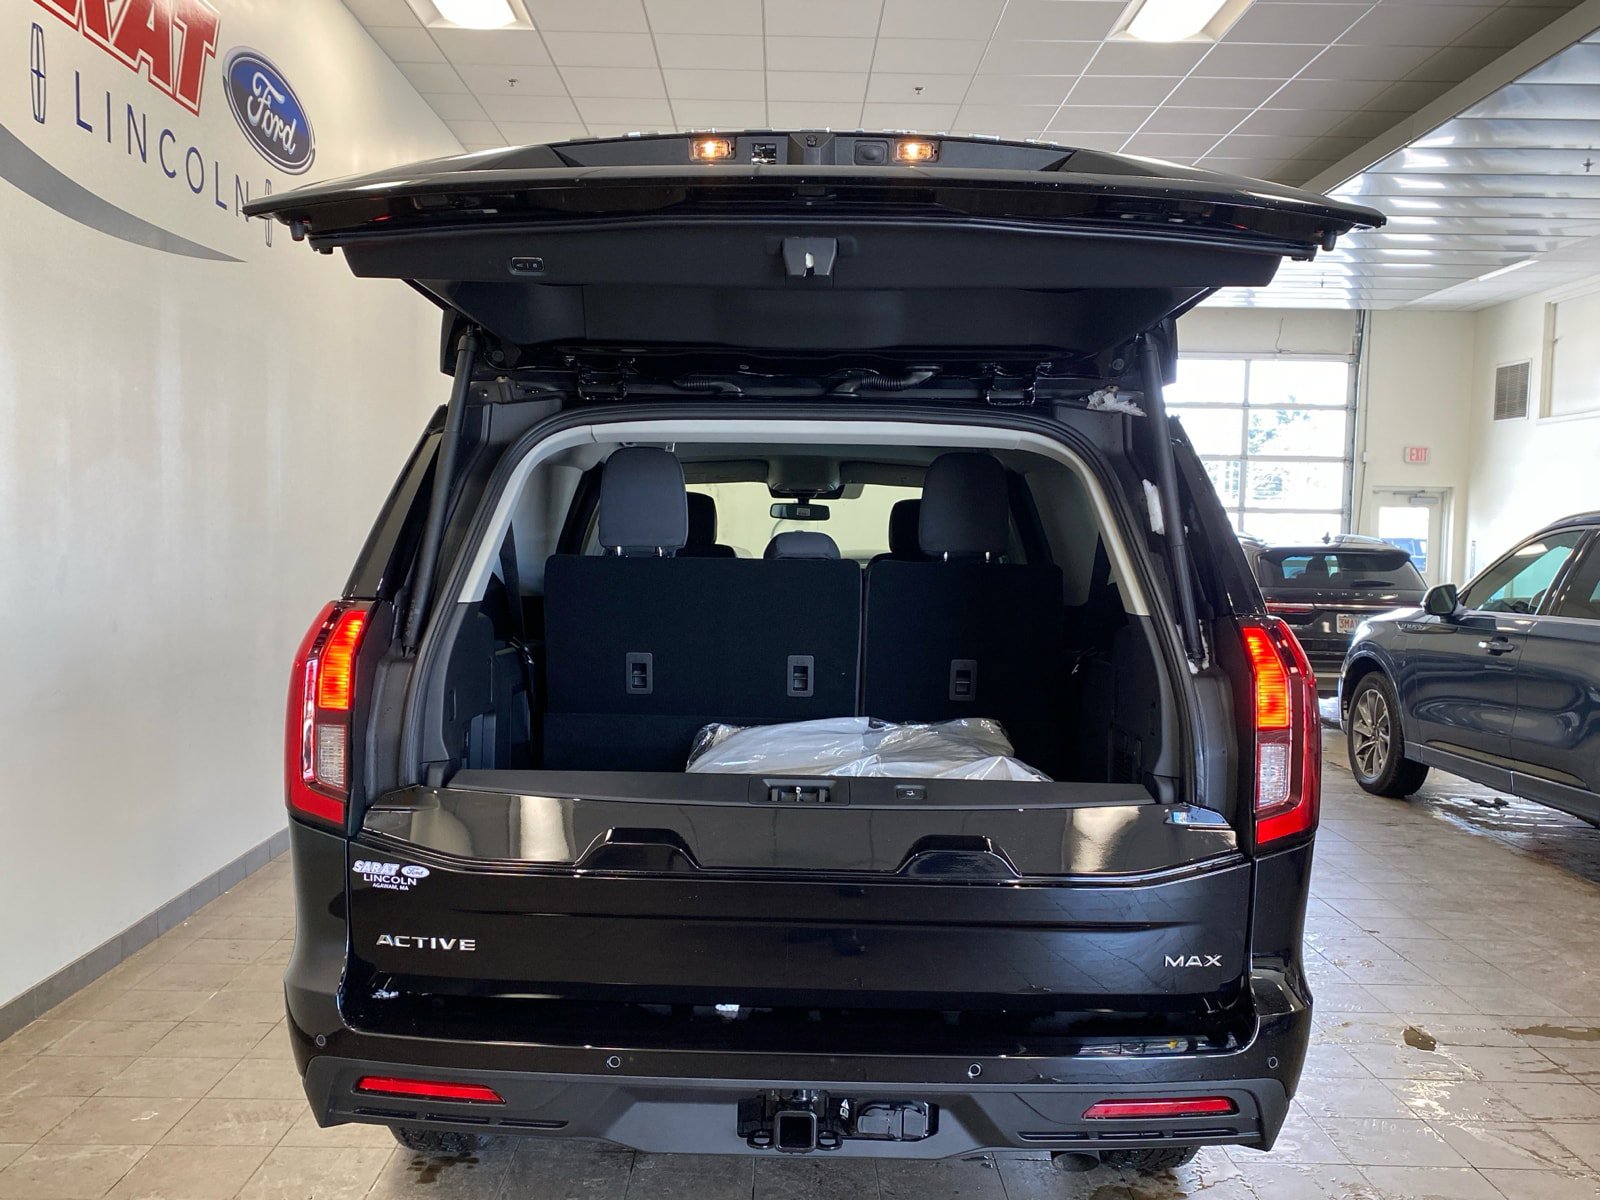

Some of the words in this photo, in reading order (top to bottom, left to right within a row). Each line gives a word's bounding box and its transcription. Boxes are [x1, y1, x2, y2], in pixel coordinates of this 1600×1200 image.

[247, 71, 298, 155] Ford
[75, 70, 249, 223] LINCOLN
[1409, 447, 1429, 462] EXIT
[352, 859, 400, 876] SARAT
[363, 873, 417, 886] LINCOLN
[376, 934, 476, 951] ACTIVE
[1164, 953, 1222, 968] MAX
